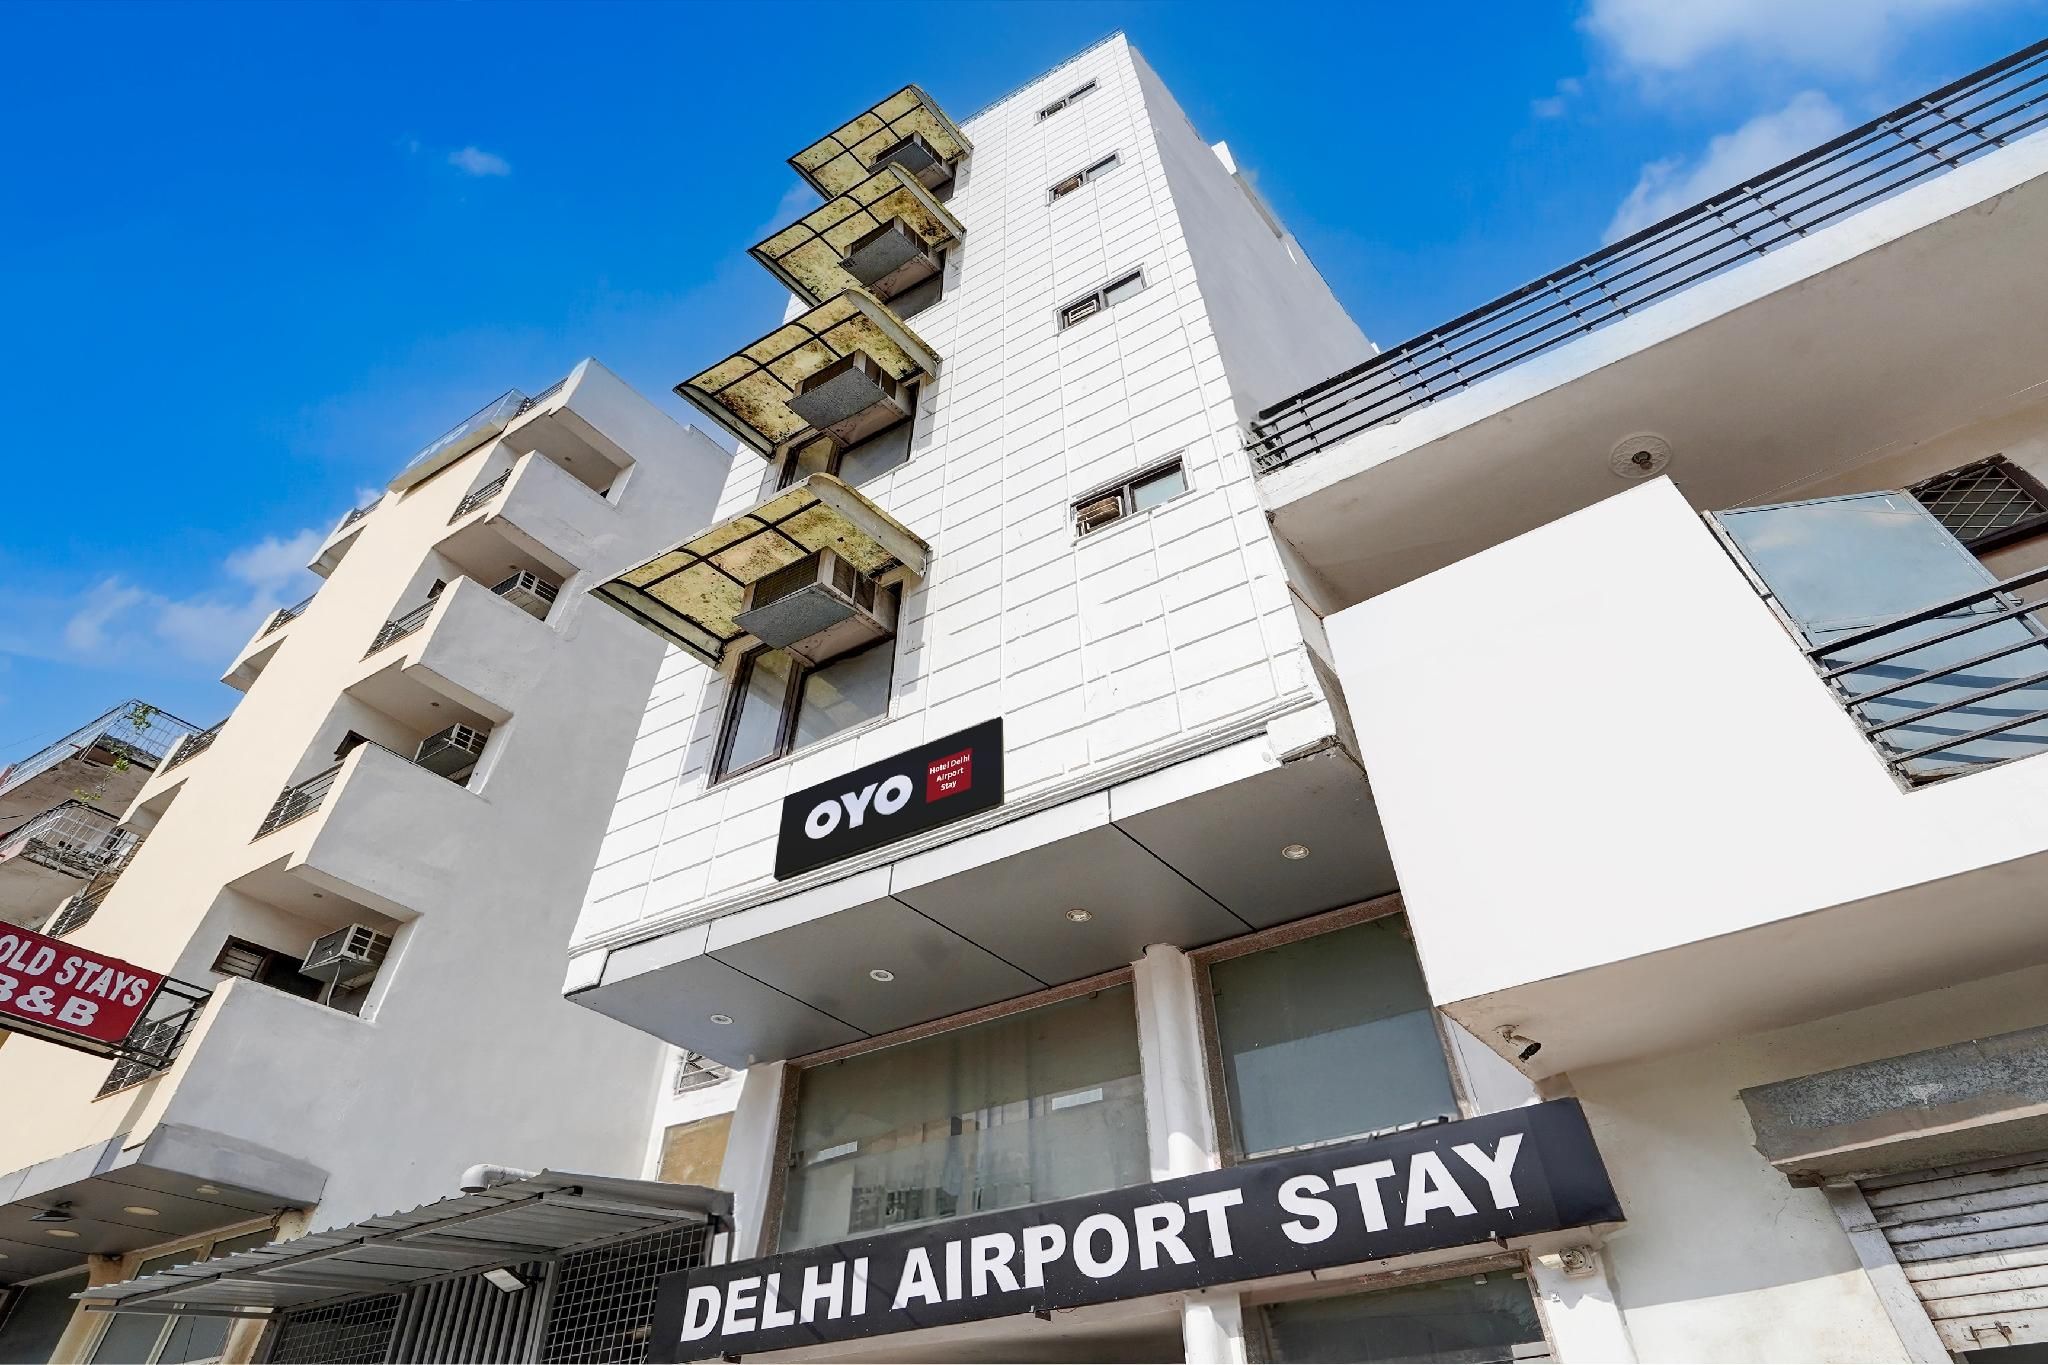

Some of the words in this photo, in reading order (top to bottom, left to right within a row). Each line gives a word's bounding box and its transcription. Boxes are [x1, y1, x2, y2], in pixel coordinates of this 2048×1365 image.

[929, 761, 950, 775] Hotel
[950, 754, 970, 768] Delhi
[936, 767, 964, 782] Airport
[940, 780, 957, 791] Stay
[804, 774, 913, 839] OYO
[0, 934, 56, 976] OLD
[54, 956, 149, 1007] STAYS
[680, 1257, 868, 1342] DELHI
[891, 1188, 1243, 1310] AIRPORT
[1277, 1133, 1524, 1244] STAY
